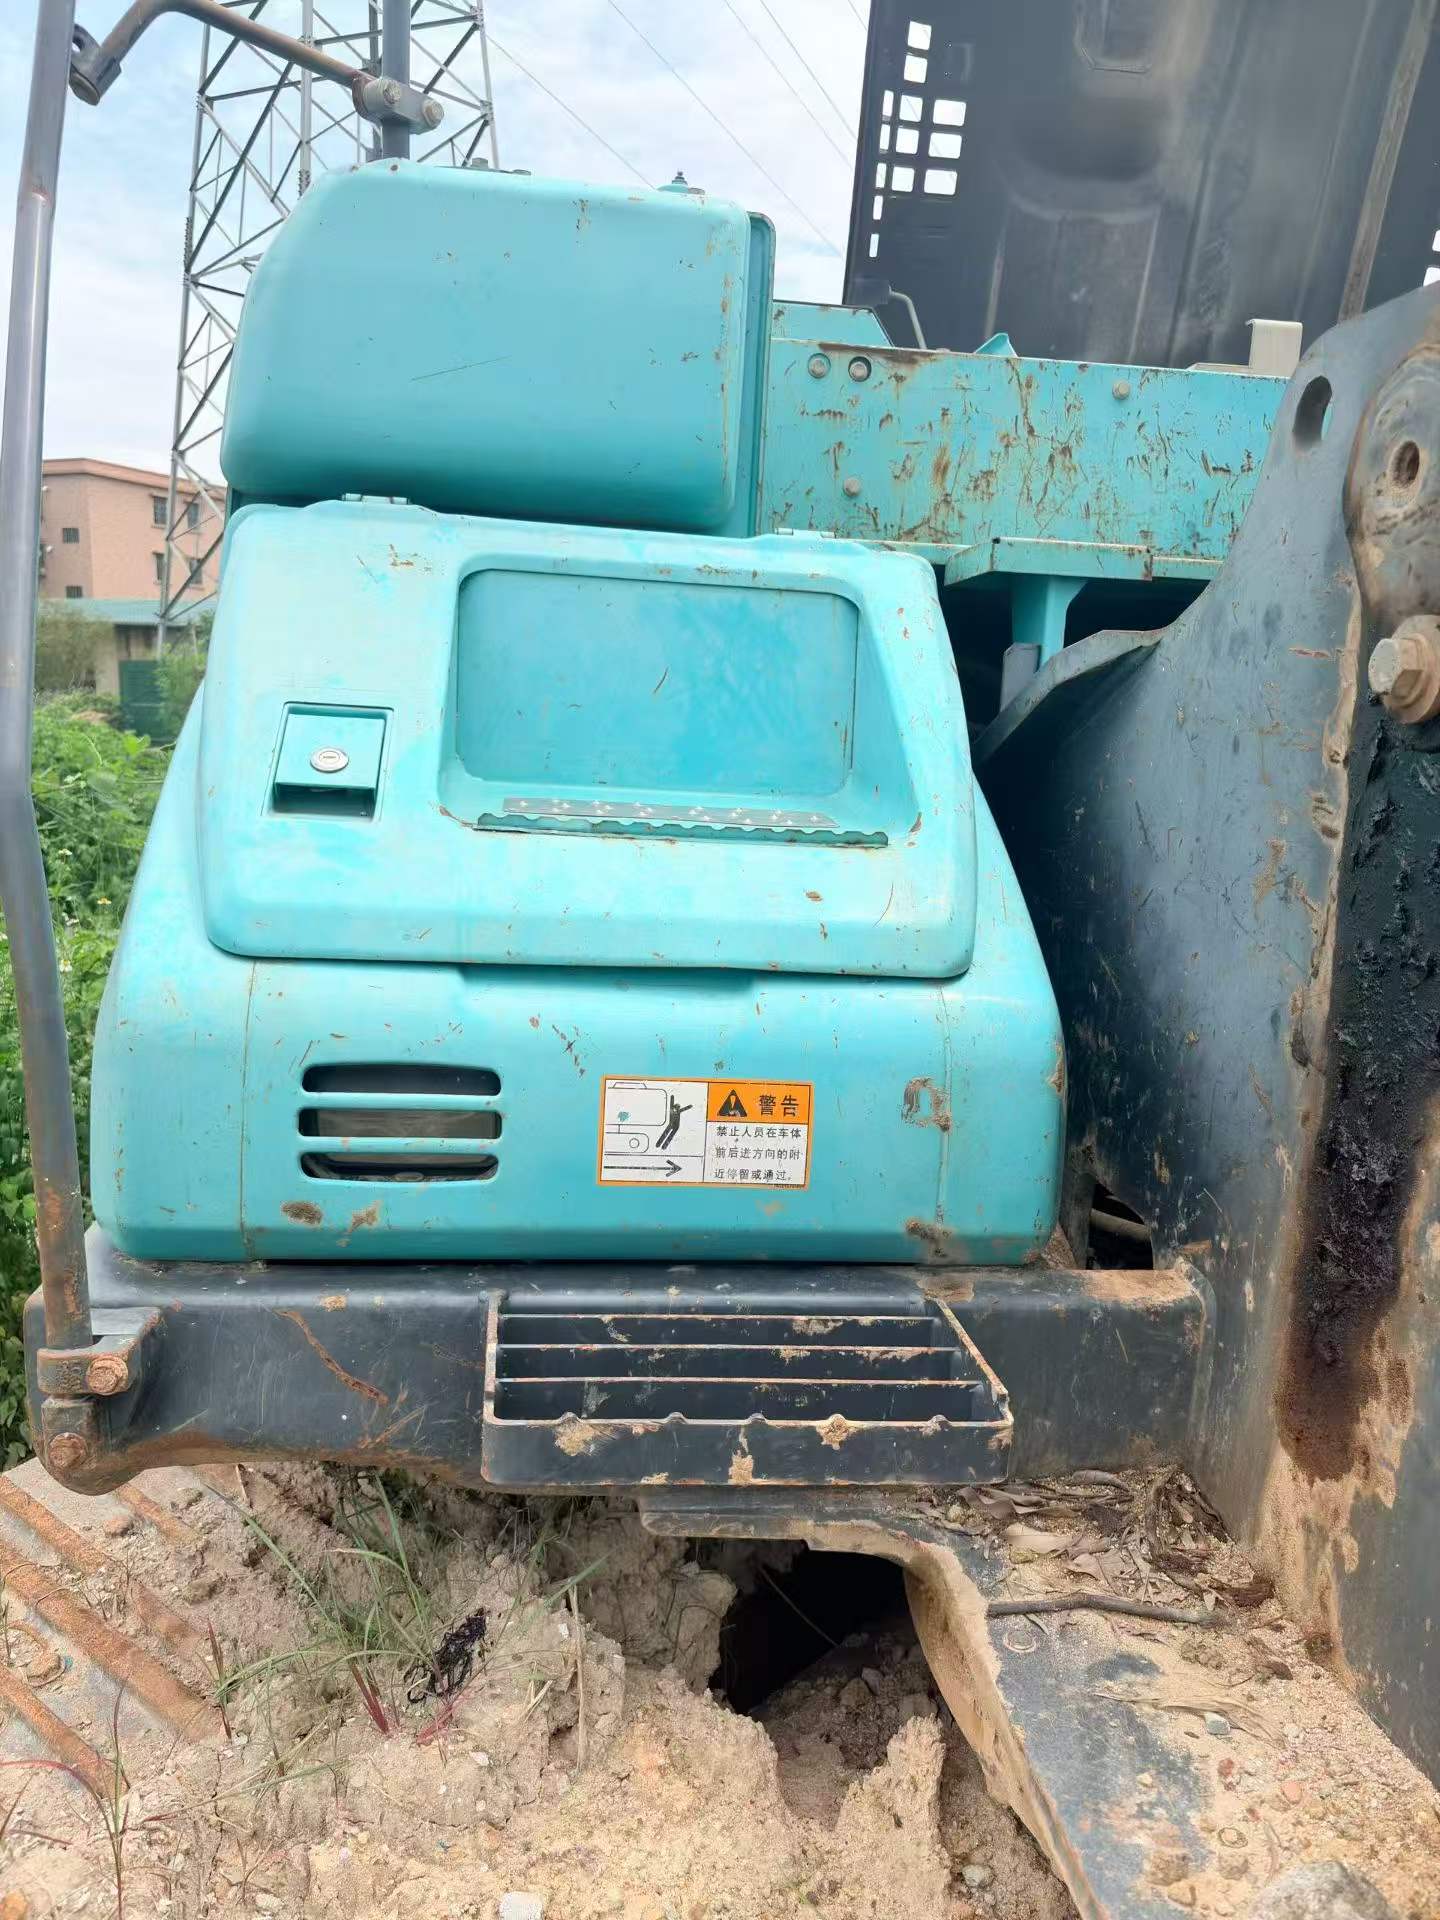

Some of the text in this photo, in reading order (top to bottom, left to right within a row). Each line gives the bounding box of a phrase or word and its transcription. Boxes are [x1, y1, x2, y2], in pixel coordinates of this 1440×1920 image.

[759, 1094, 799, 1116] 警告
[716, 1126, 801, 1138] 禁止人员在车体
[715, 1146, 800, 1160] 前后进方向的附
